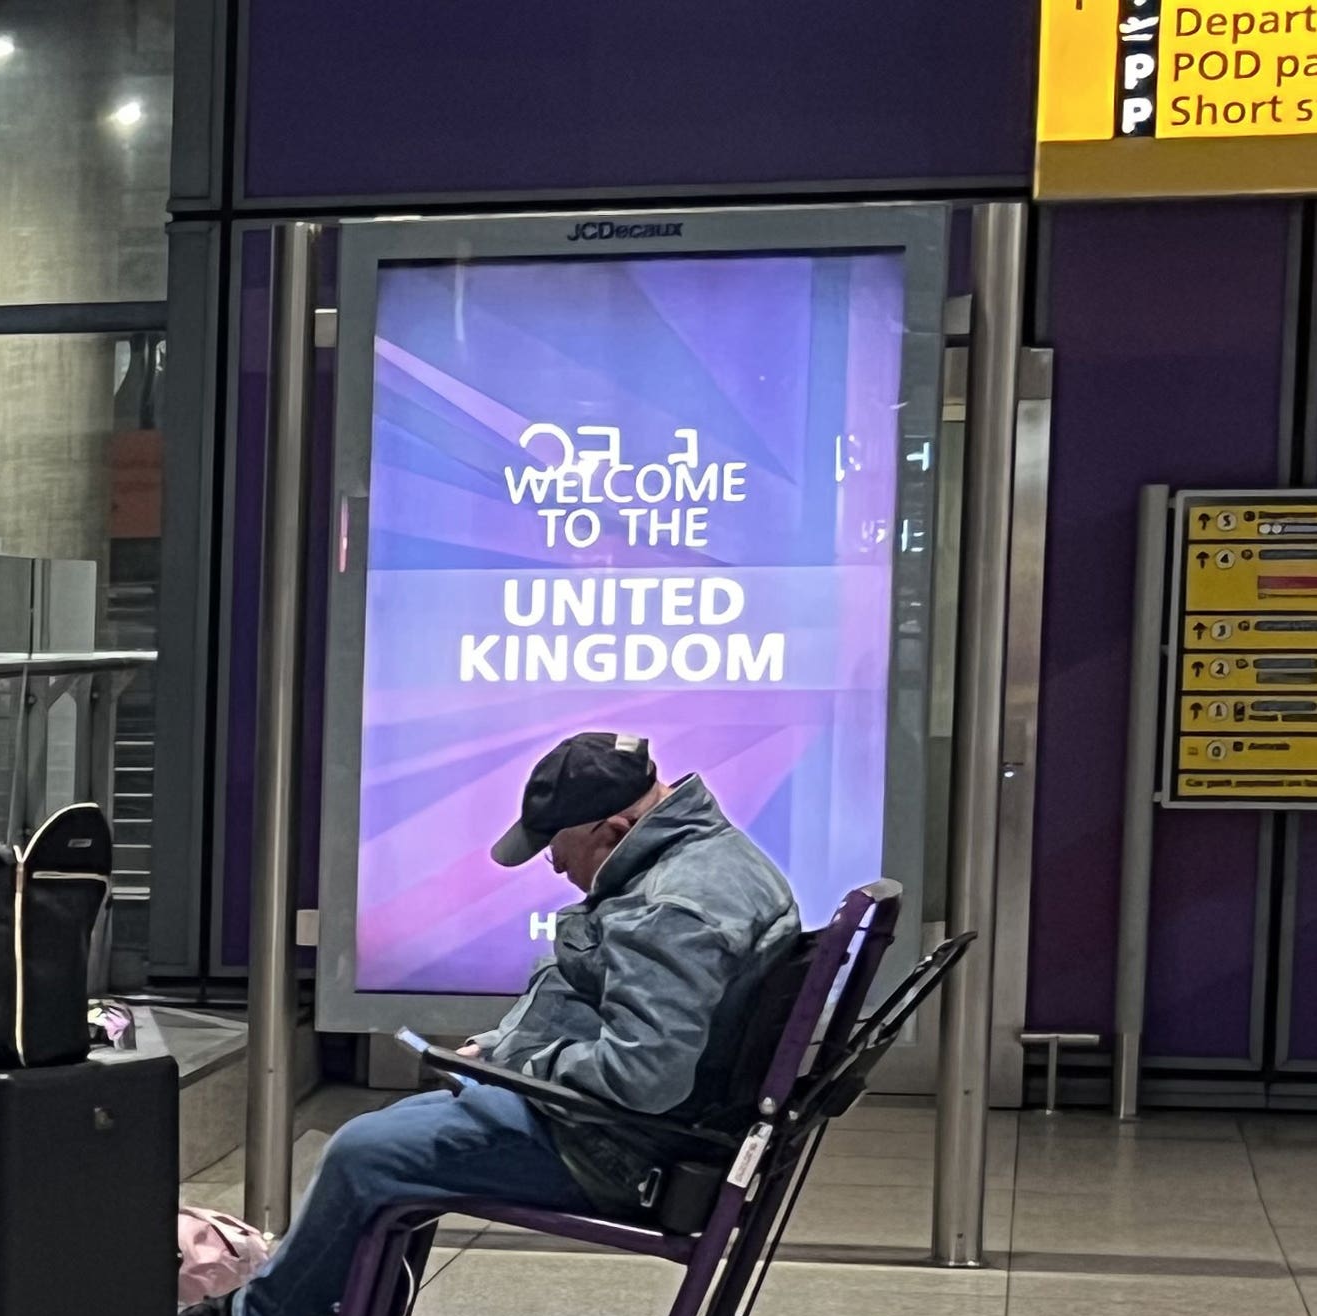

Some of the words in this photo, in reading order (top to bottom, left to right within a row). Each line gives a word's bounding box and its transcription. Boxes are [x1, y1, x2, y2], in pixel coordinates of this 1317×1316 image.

[1176, 5, 1317, 44] Depart
[1173, 50, 1261, 81] POD
[1171, 94, 1283, 126] Short
[567, 222, 684, 241] JCDecaux
[504, 462, 748, 504] WELCOME
[537, 507, 601, 548] TO
[618, 507, 709, 548] THE
[503, 577, 745, 627] UNITED
[459, 632, 785, 683] KINGDOM
